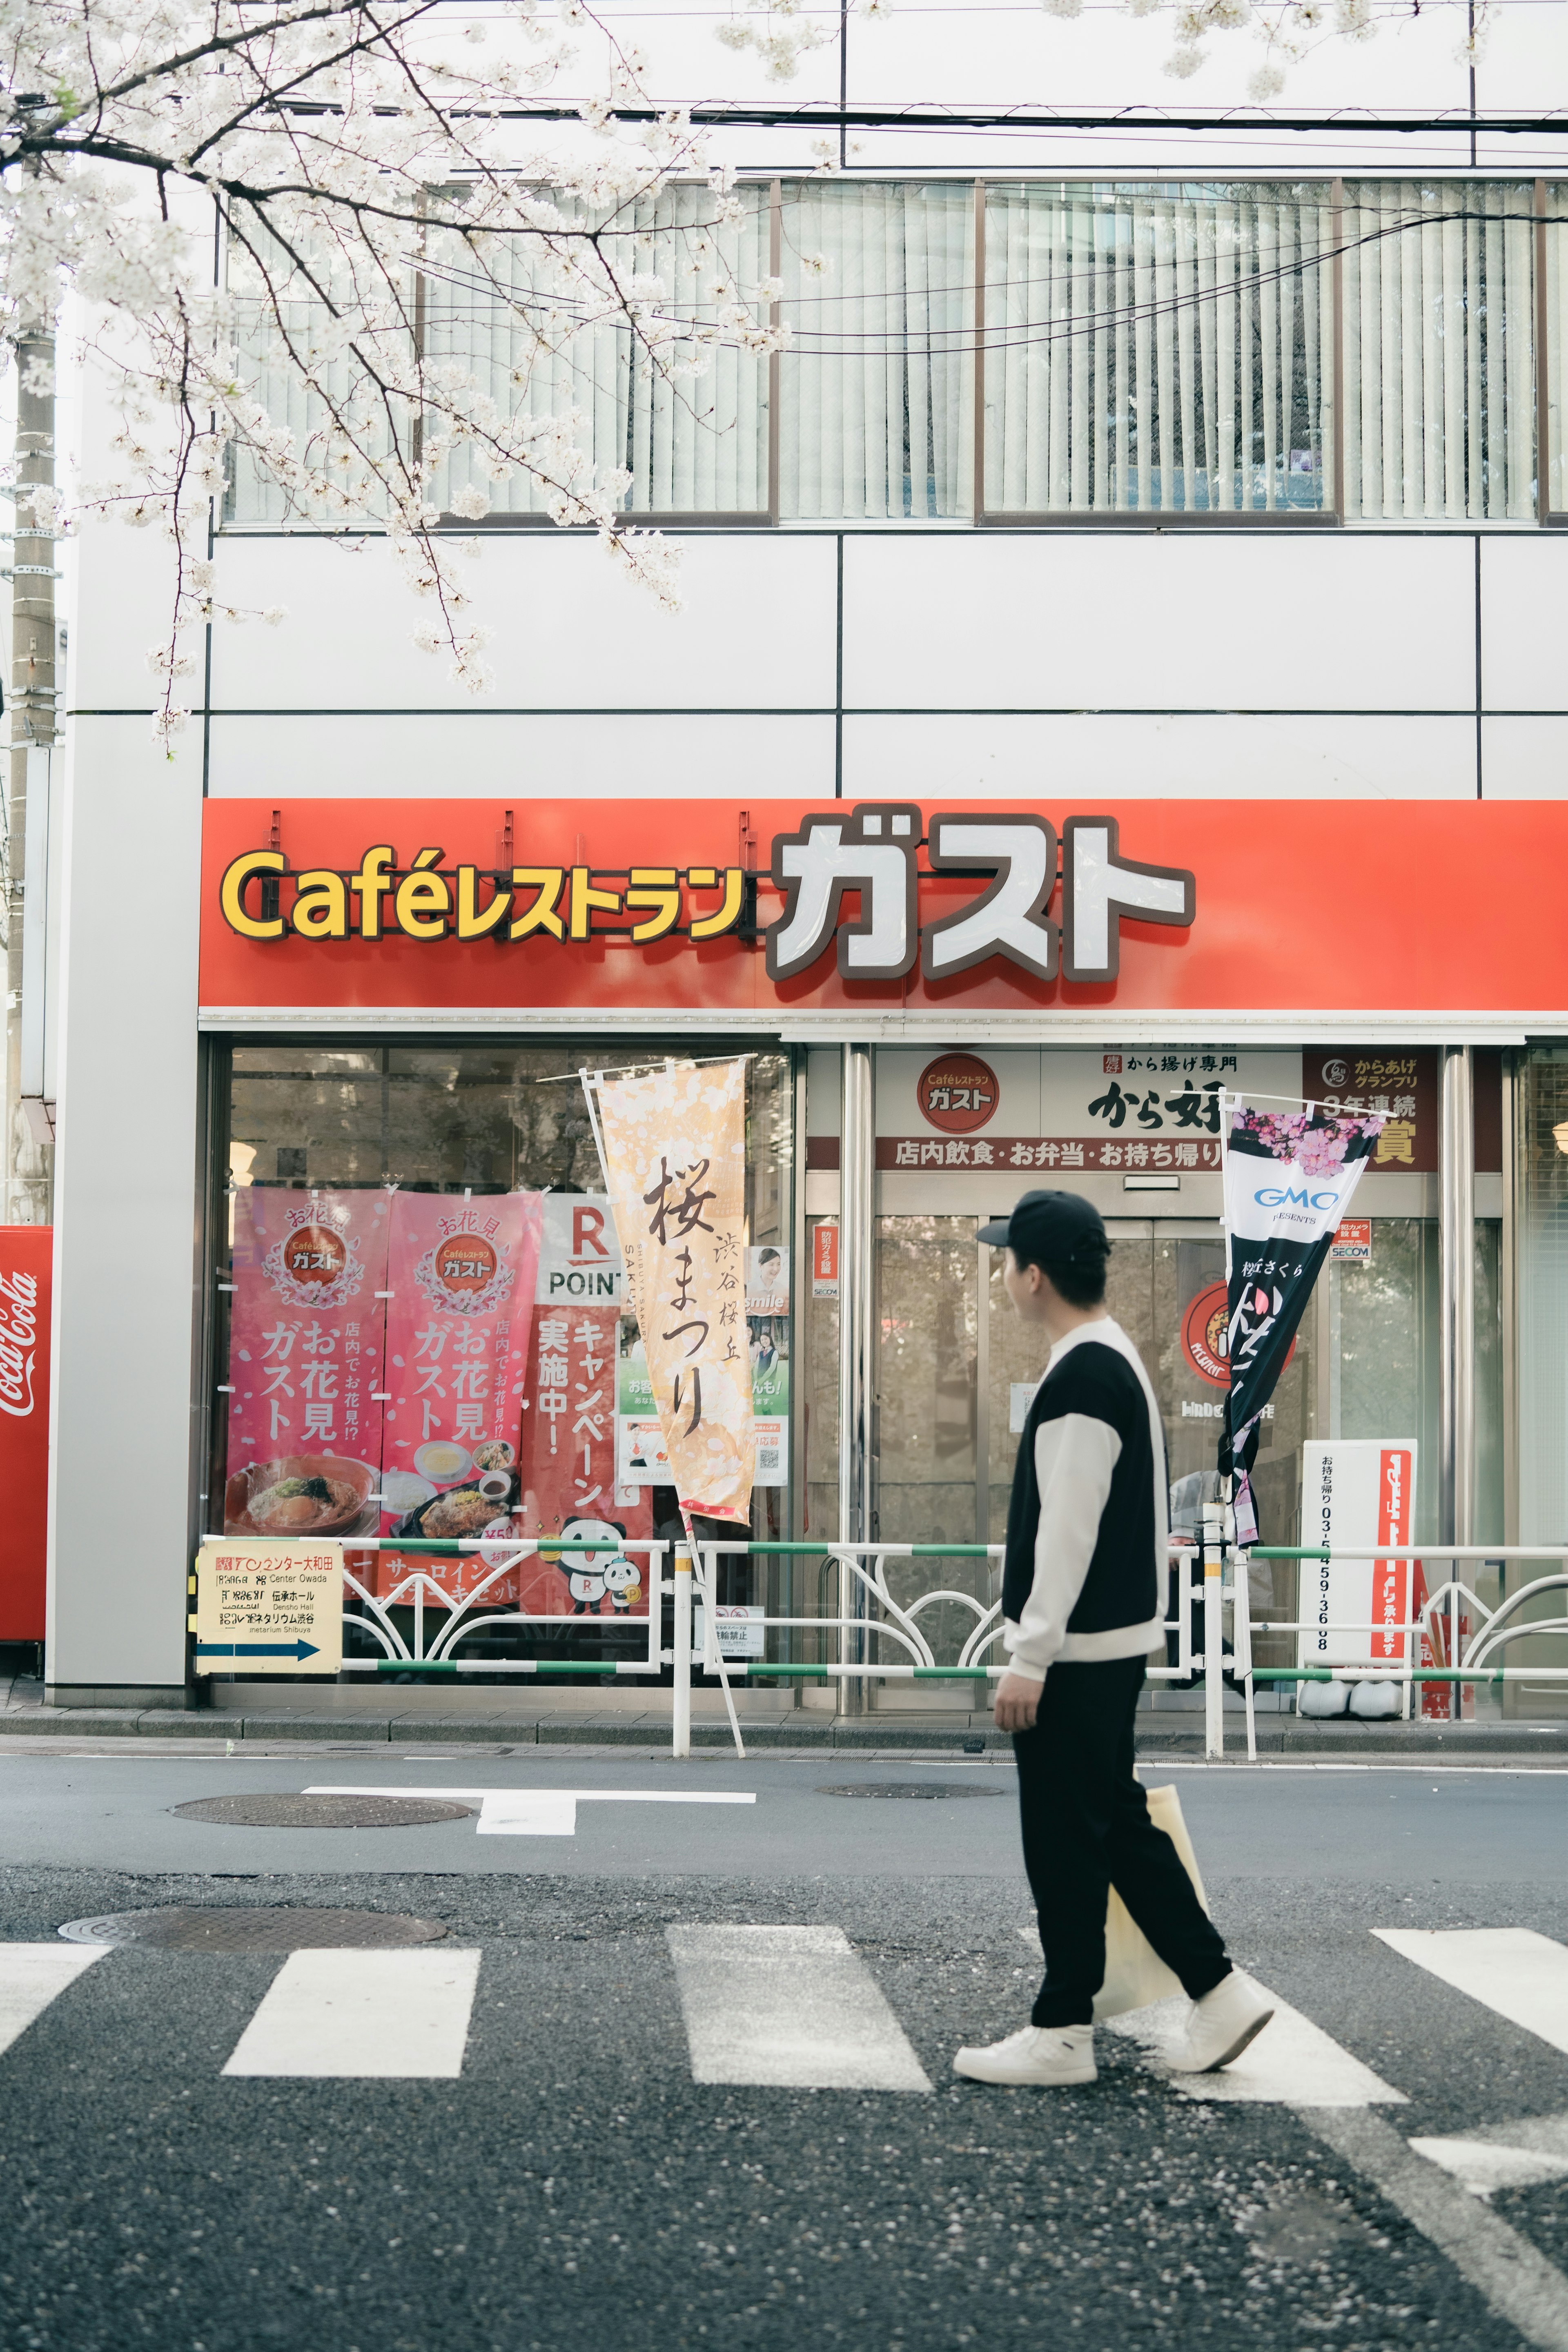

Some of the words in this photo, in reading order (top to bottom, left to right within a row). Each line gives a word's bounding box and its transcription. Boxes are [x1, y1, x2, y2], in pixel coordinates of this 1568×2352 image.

[220, 844, 748, 945] Caféレストラン
[766, 803, 1196, 982] ガスト
[1127, 1056, 1237, 1072] から揚げ専門
[1355, 1059, 1417, 1074] からあげ
[928, 1074, 989, 1085] Caféレストラン
[1355, 1076, 1417, 1088] グランプリ
[928, 1087, 992, 1111] ガスト
[1323, 1095, 1416, 1118] 3年連続
[1254, 1186, 1339, 1210] GMO
[438, 1211, 500, 1240] お花見
[292, 1252, 340, 1270] ガスト
[1332, 1247, 1368, 1256] SECOM
[443, 1260, 491, 1278] ガスト
[550, 1272, 621, 1295] POIN
[643, 1156, 717, 1439] 桜まつり
[259, 1321, 302, 1440] ガスト
[300, 1320, 340, 1441] お花見
[412, 1321, 454, 1440] ガスト
[451, 1321, 490, 1441] お花見
[572, 1319, 604, 1508] キャンペーン
[1321, 1456, 1333, 1504] お持ち帰り
[270, 1574, 296, 1583] Center
[299, 1574, 327, 1582] Owada
[385, 1558, 488, 1583] サーロイン
[272, 1591, 314, 1601] 伝承ホール
